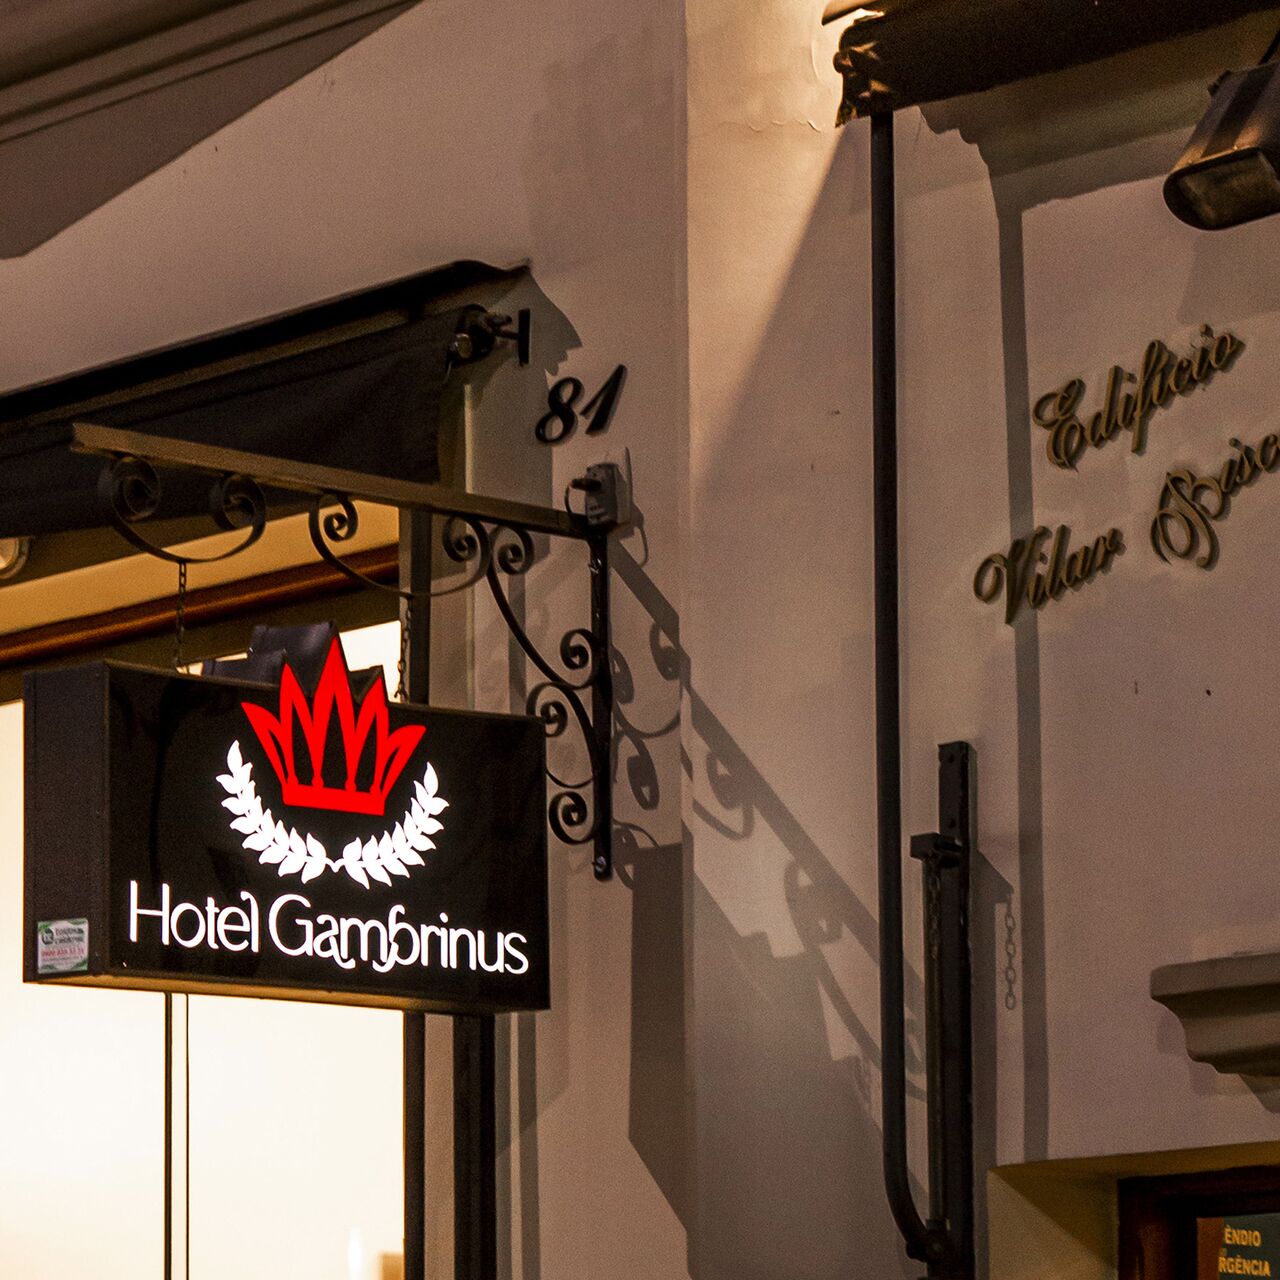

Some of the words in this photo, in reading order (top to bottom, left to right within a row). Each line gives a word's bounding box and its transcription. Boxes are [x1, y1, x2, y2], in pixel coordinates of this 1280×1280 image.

[535, 365, 627, 443] 81
[129, 880, 259, 953] Hotel
[268, 893, 529, 974] Gambrinus
